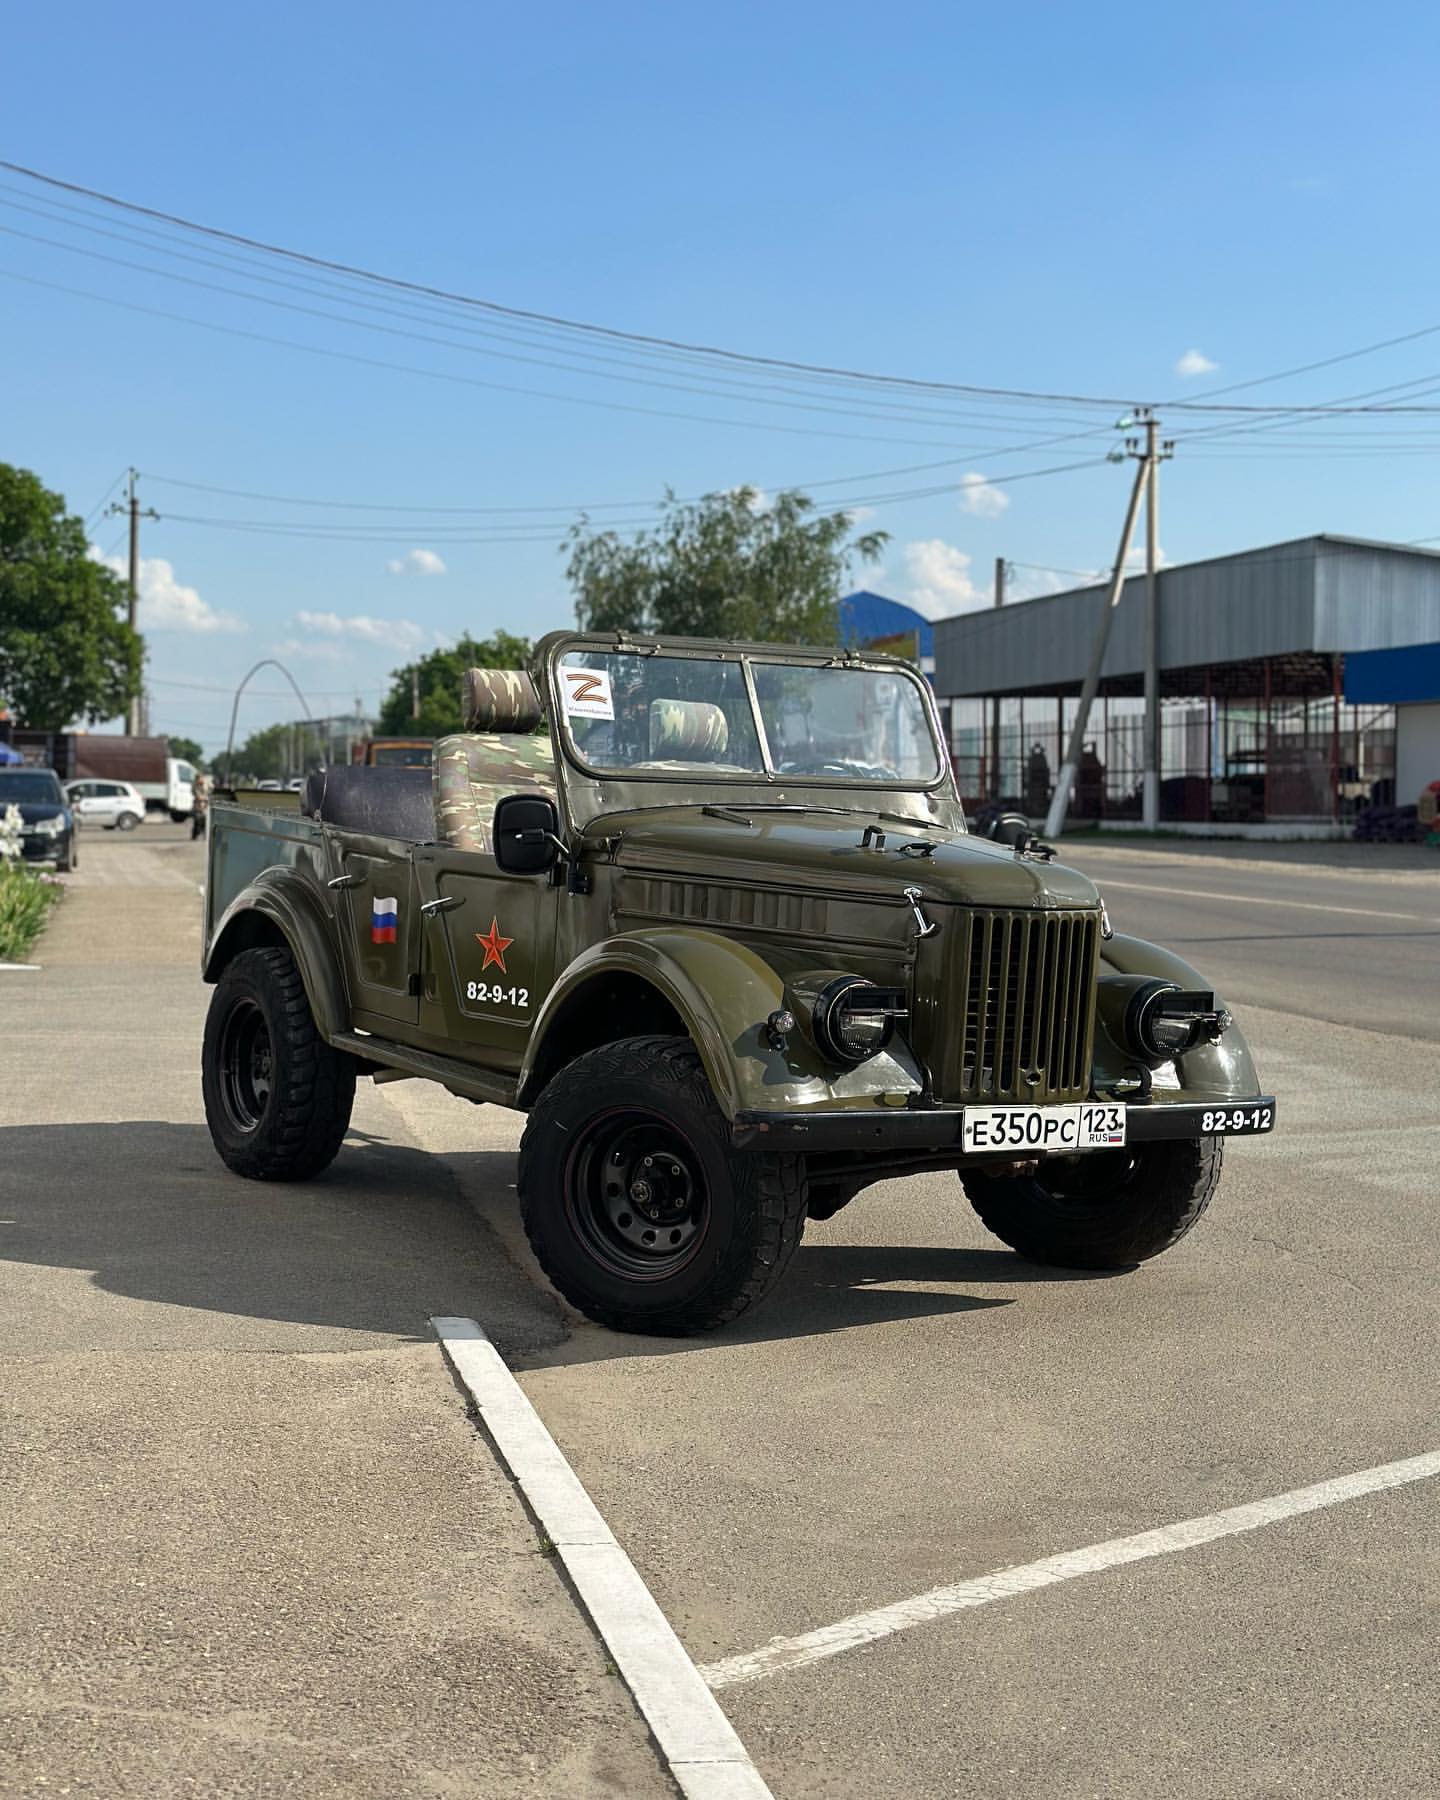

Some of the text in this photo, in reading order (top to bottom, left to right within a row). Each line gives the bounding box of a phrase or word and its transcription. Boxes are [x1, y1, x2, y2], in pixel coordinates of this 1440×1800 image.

[566, 673, 608, 705] Z
[467, 981, 529, 1007] 82-9-12
[1083, 1108, 1119, 1133] 123
[1202, 1109, 1271, 1132] 82-9-12
[1089, 1133, 1108, 1143] RUS
